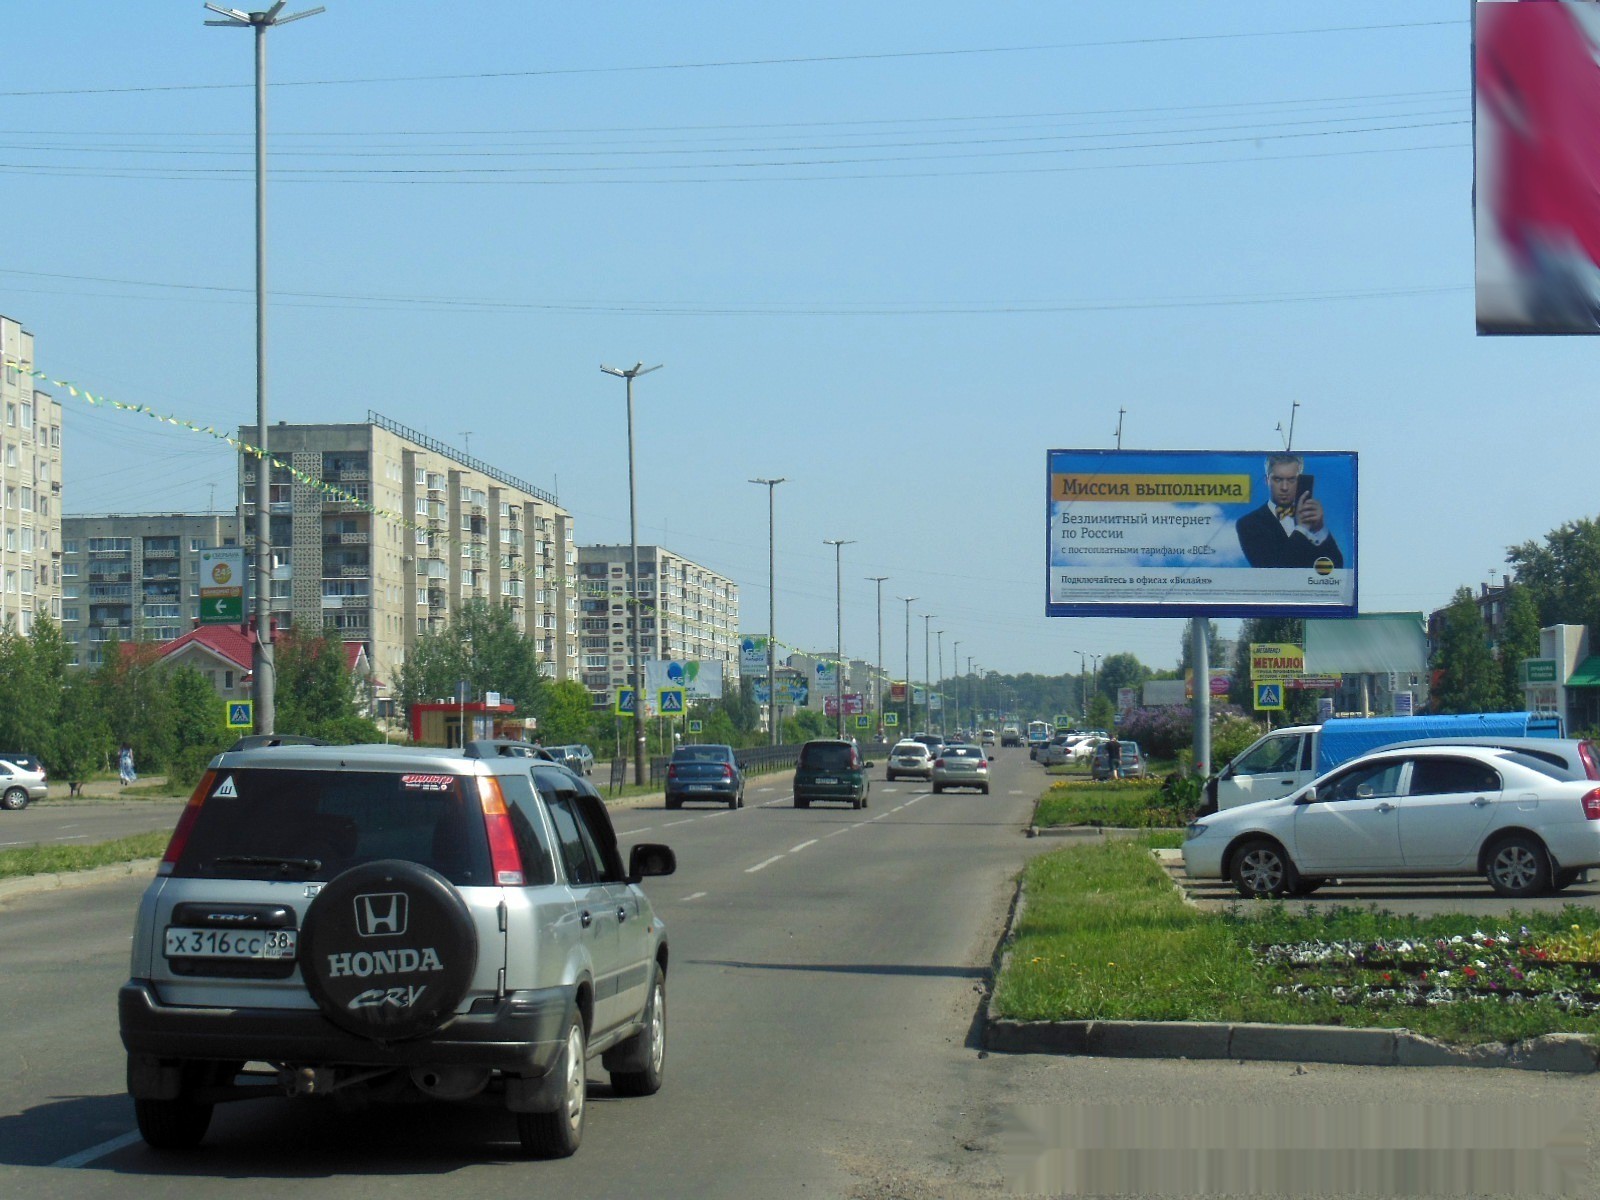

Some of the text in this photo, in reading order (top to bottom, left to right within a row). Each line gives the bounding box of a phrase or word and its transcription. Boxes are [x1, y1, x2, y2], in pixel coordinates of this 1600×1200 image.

[1062, 479, 1243, 497] Миссия выполнима
[1062, 513, 1212, 528] Безлимитный интернет
[1061, 527, 1124, 539] по России
[1068, 547, 1139, 555] постоплатными
[1141, 546, 1185, 557] тарифами
[1061, 575, 1126, 585] Подключайтесь
[1136, 576, 1167, 586] офисах
[1307, 577, 1340, 586] Билайн
[220, 785, 233, 795] Ш
[267, 932, 289, 949] 38
[327, 947, 444, 978] HONDA
